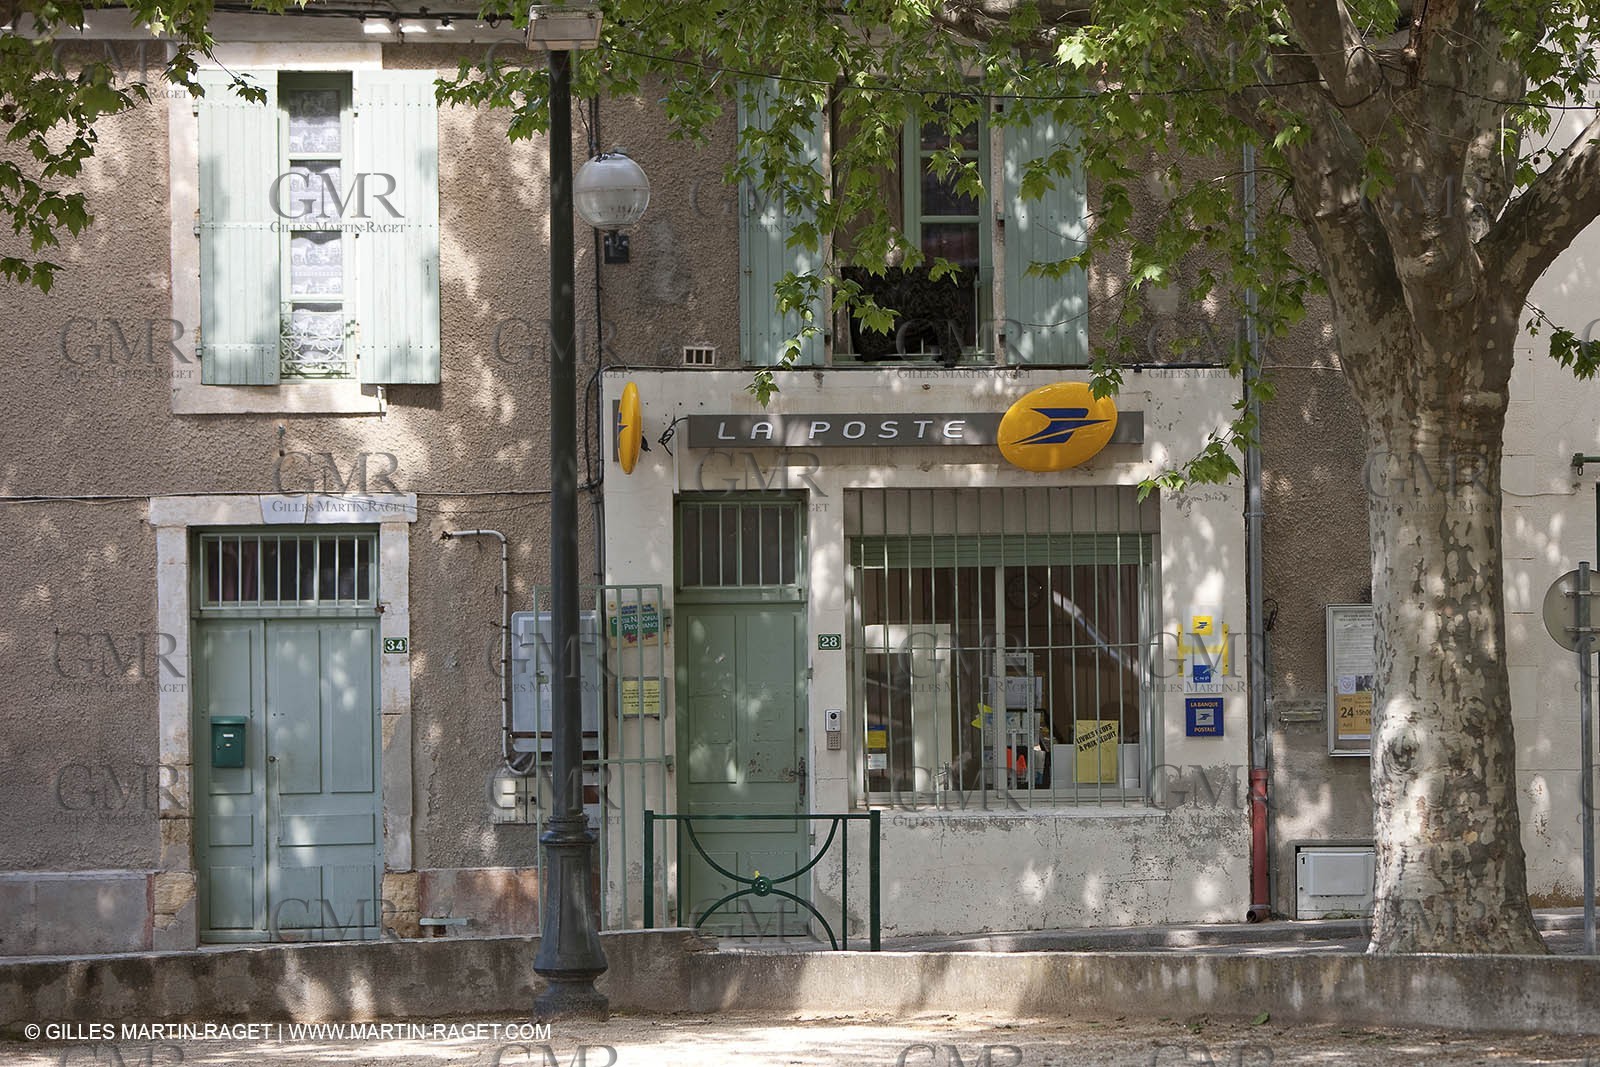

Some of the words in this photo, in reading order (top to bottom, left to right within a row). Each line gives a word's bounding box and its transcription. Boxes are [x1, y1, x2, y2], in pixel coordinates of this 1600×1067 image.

[717, 421, 774, 440] LA
[808, 420, 967, 440] POSTE
[386, 639, 404, 651] 34
[821, 636, 838, 647] 28
[1340, 706, 1354, 718] 24
[1075, 731, 1096, 744] LIVRES
[1083, 740, 1098, 750] PRIX
[1301, 856, 1305, 865] 1
